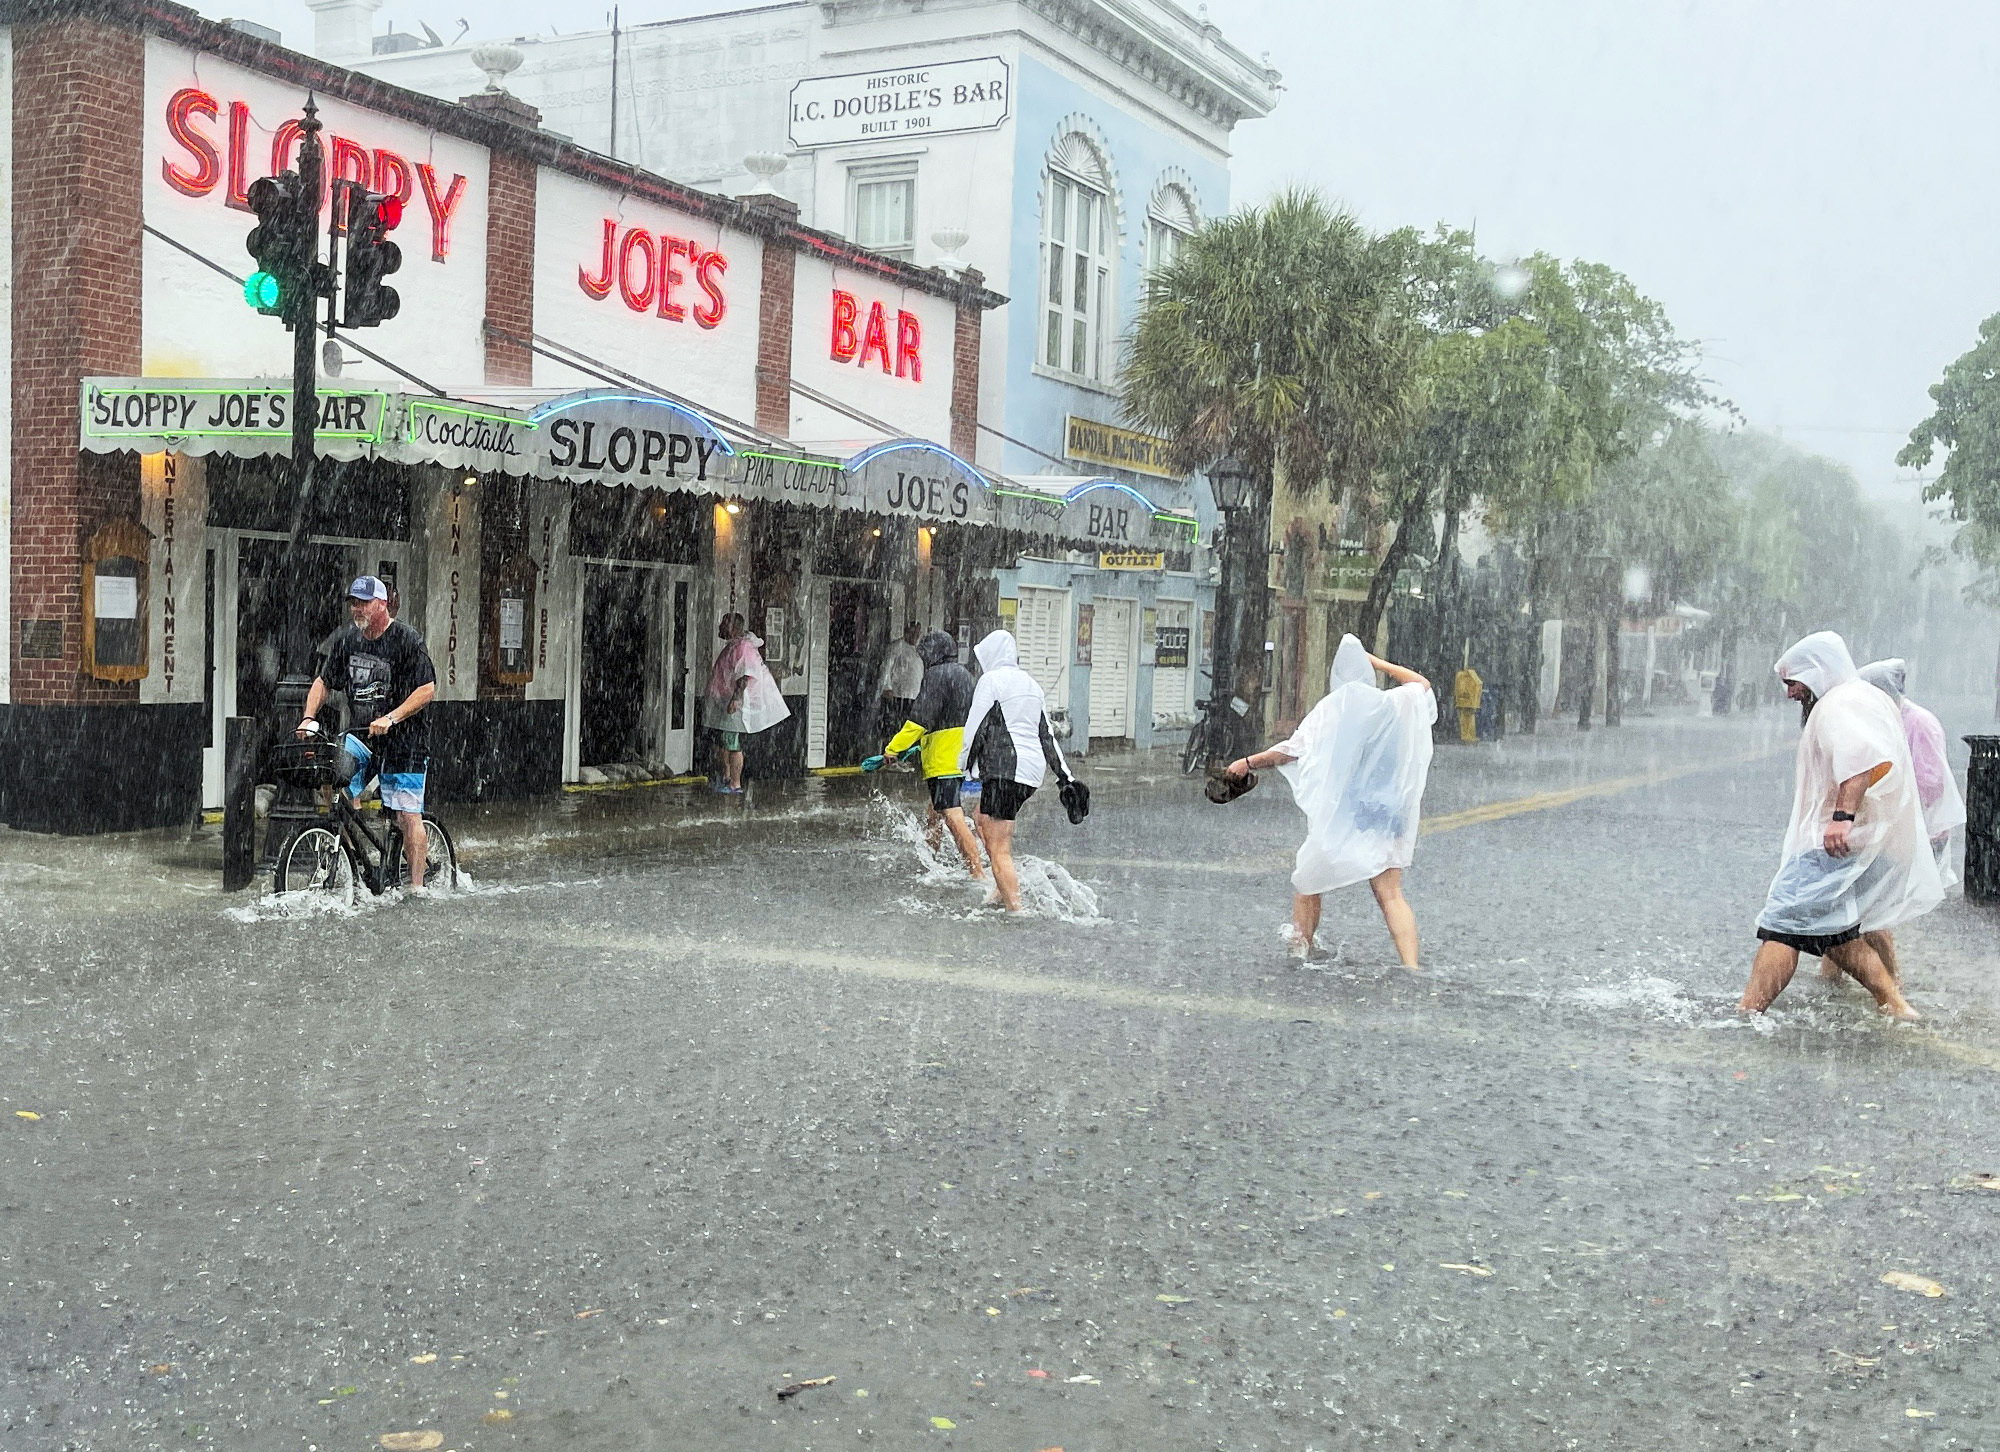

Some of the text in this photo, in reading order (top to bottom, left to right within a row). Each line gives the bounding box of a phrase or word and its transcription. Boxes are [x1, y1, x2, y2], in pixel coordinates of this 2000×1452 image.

[793, 80, 1004, 123] I.C. DOUBLE'S BAR
[866, 72, 930, 90] HISTORIC
[861, 117, 932, 134] BUILT 1901
[162, 88, 468, 264] SLOPPY
[578, 218, 728, 330] JOE'S
[830, 288, 923, 384] BAR
[94, 392, 198, 430] SLOPPY
[208, 388, 286, 429] JOE'S
[425, 413, 521, 456] Cocktails
[548, 418, 717, 481] SLOPPY
[783, 461, 849, 496] COLADAS
[887, 472, 969, 518] JOE'S
[1087, 503, 1129, 541] BAR
[164, 449, 176, 693] NTERTAINMENT
[1105, 556, 1158, 566] OUTLET
[1329, 566, 1376, 578] crocs
[539, 608, 549, 669] BEER
